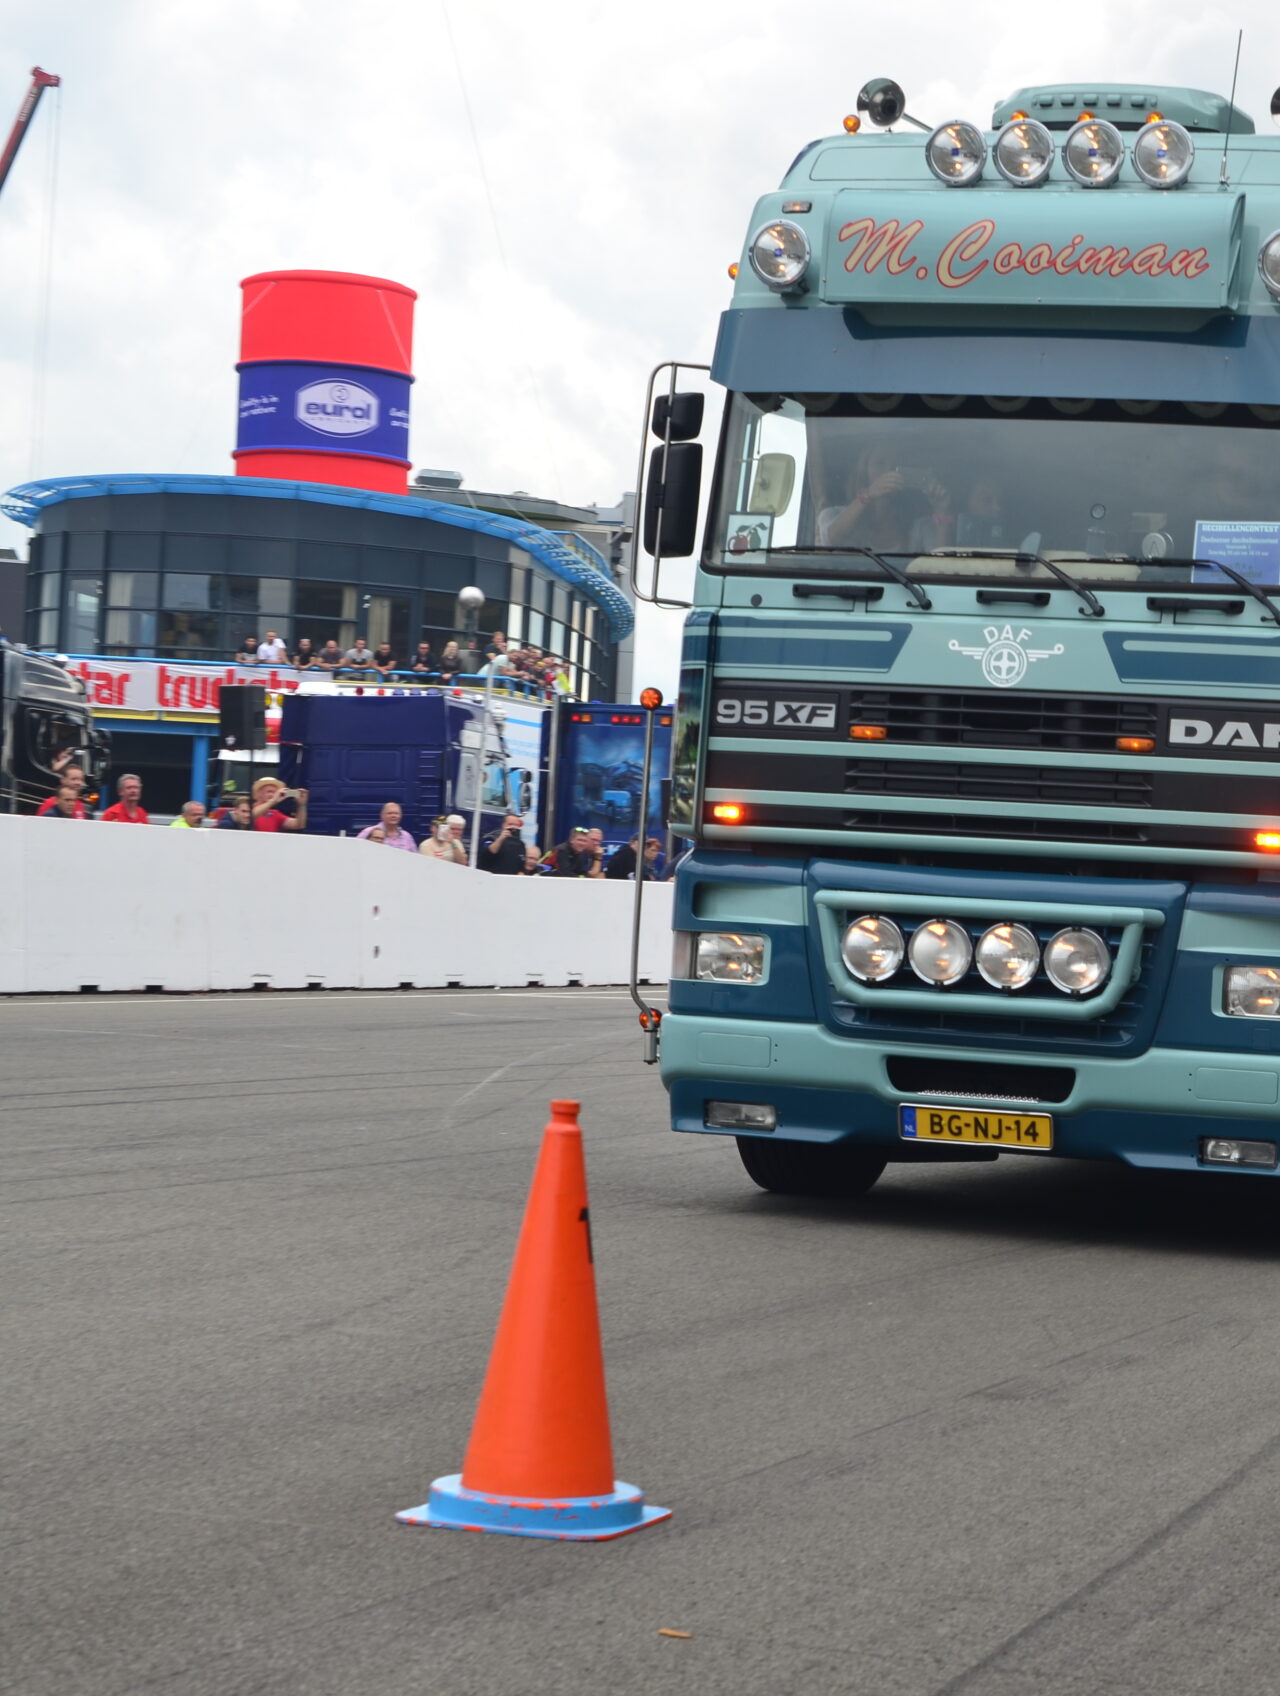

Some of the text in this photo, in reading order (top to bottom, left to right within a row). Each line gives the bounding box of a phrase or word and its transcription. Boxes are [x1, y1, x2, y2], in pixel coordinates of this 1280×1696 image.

[305, 402, 372, 420] eurol
[983, 624, 1033, 644] DAF
[905, 1112, 1039, 1143] NL BG-NJ-14
